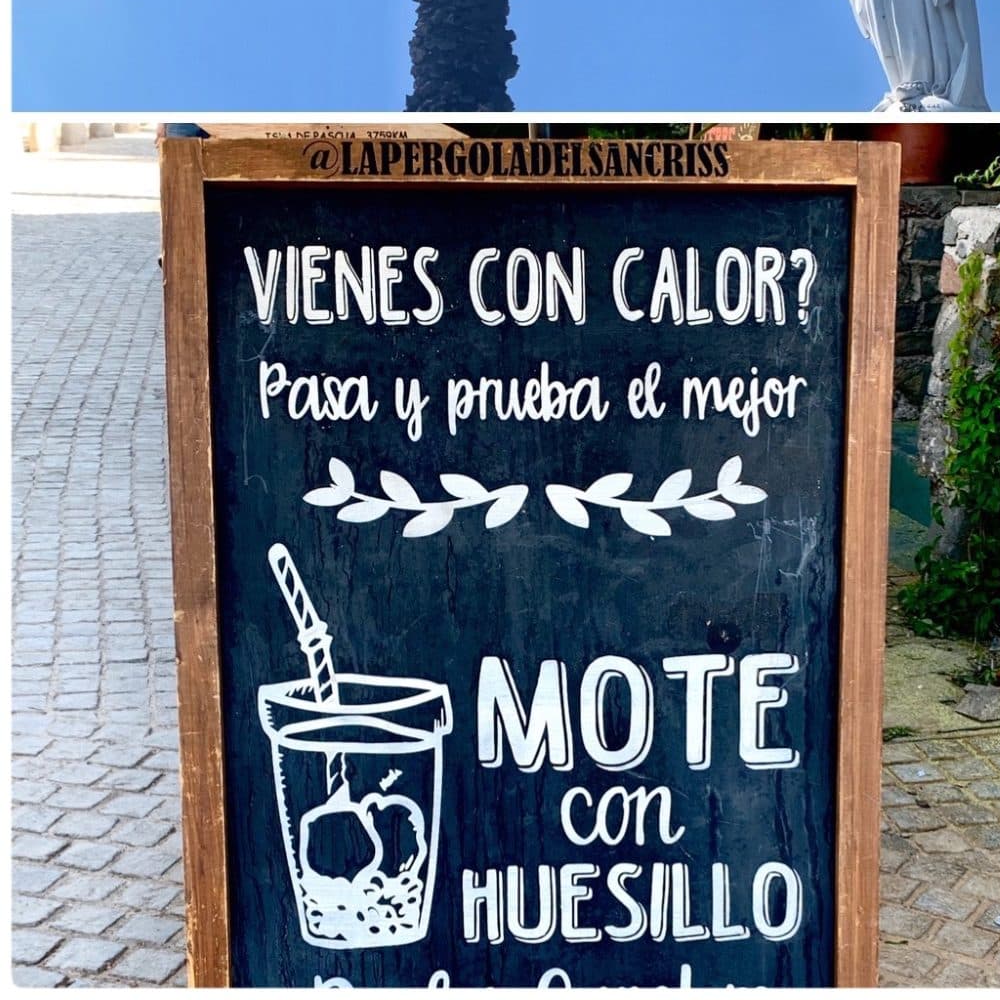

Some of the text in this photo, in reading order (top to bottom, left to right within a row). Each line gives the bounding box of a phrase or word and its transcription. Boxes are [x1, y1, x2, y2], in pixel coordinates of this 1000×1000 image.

[302, 140, 729, 178] @LAPERGOLADELSANCRISS
[244, 246, 817, 326] VIENES CON CALOR?
[260, 361, 807, 441] Pasa y prueba el mejor
[478, 654, 799, 772] MOTE
[561, 787, 685, 845] con
[463, 862, 802, 944] HUESILLO
